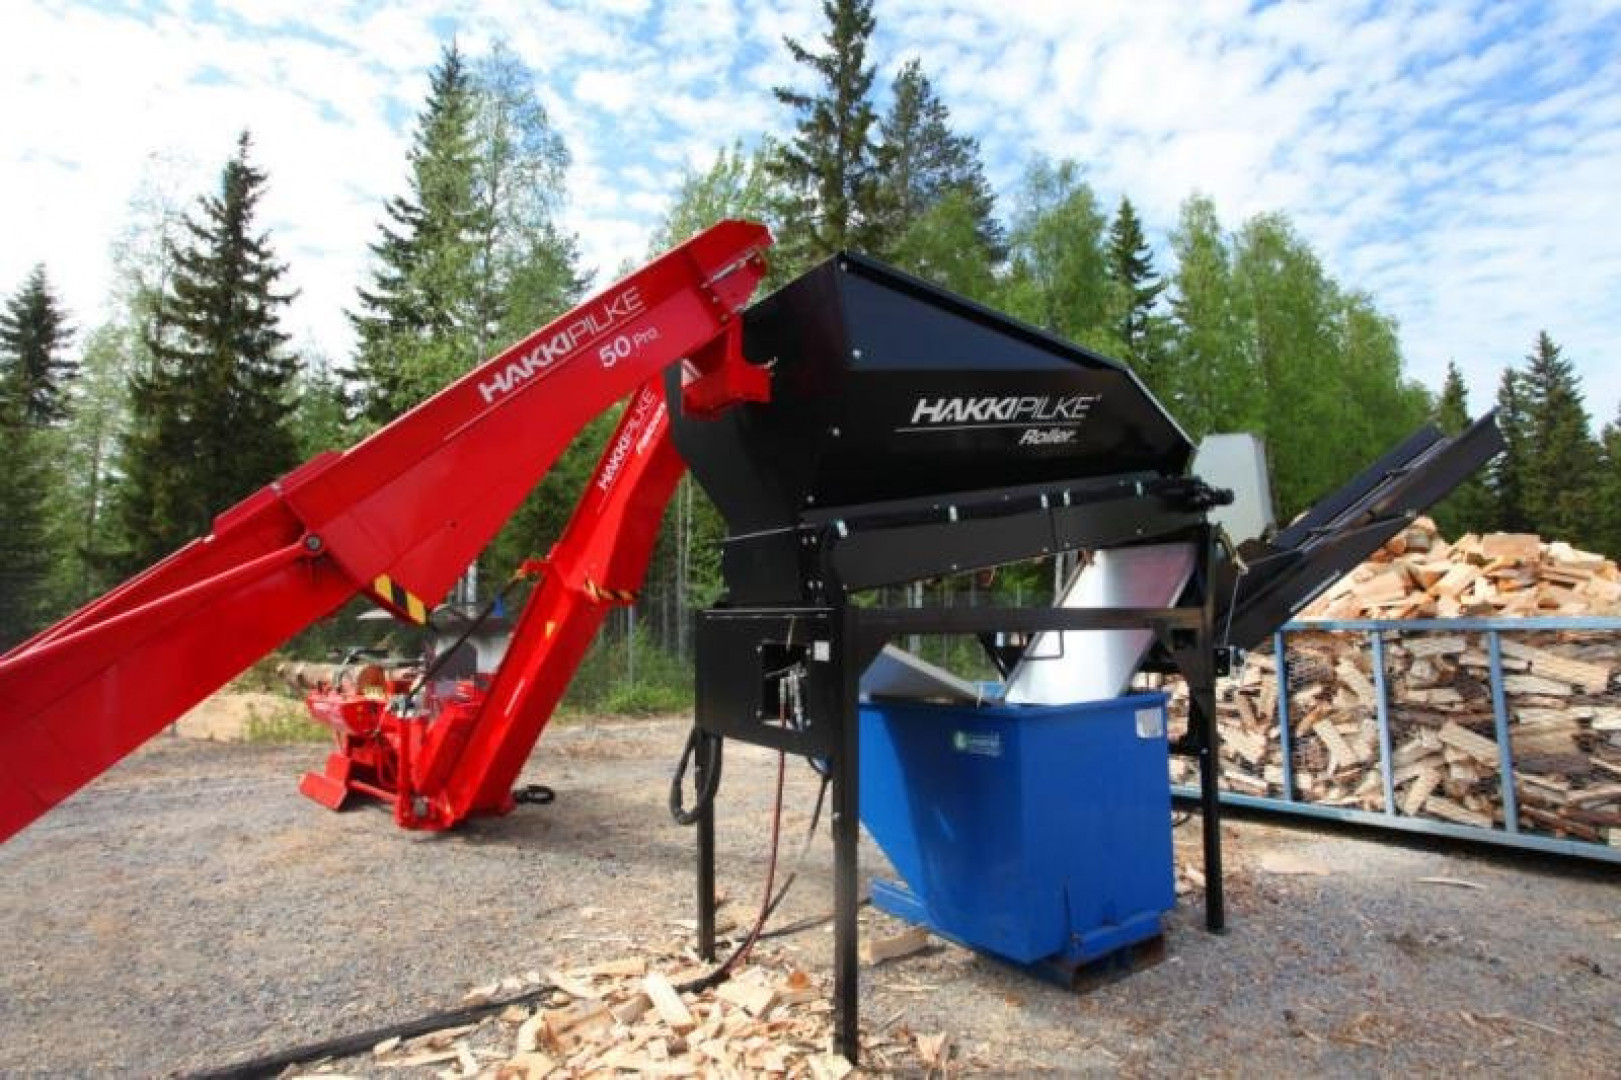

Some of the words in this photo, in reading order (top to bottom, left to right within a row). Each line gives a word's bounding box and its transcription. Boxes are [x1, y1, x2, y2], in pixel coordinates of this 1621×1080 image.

[477, 285, 644, 403] HAKKIPILKE
[599, 335, 631, 368] 50
[631, 326, 658, 349] Pro
[911, 396, 1096, 424] HAKKIPILKE
